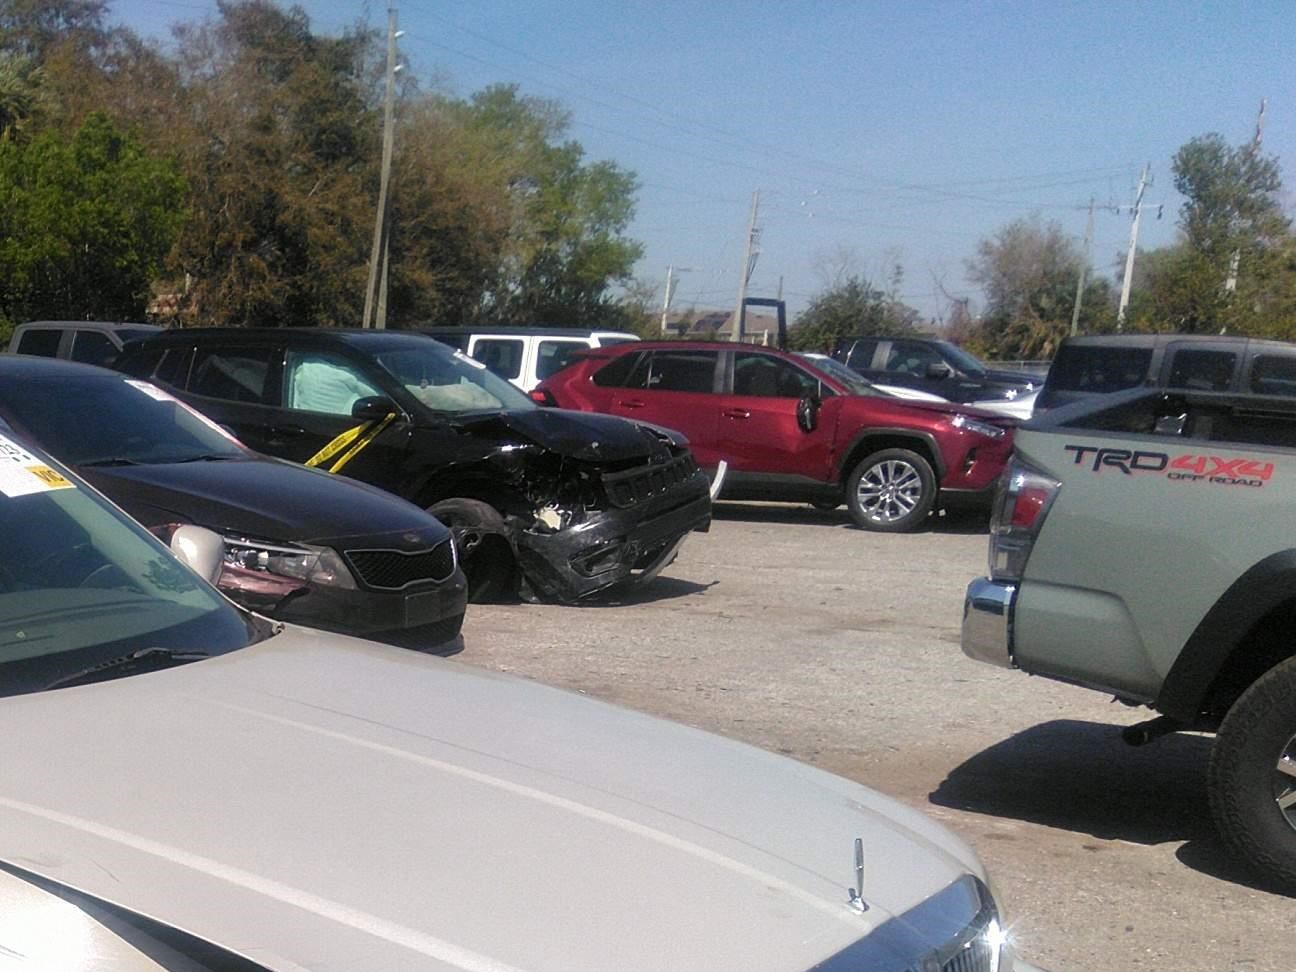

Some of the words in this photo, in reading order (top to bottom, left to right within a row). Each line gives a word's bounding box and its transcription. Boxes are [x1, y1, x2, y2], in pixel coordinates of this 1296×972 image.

[1064, 444, 1170, 475] TRD
[1167, 471, 1205, 482] OFF
[1209, 475, 1264, 488] ROAD
